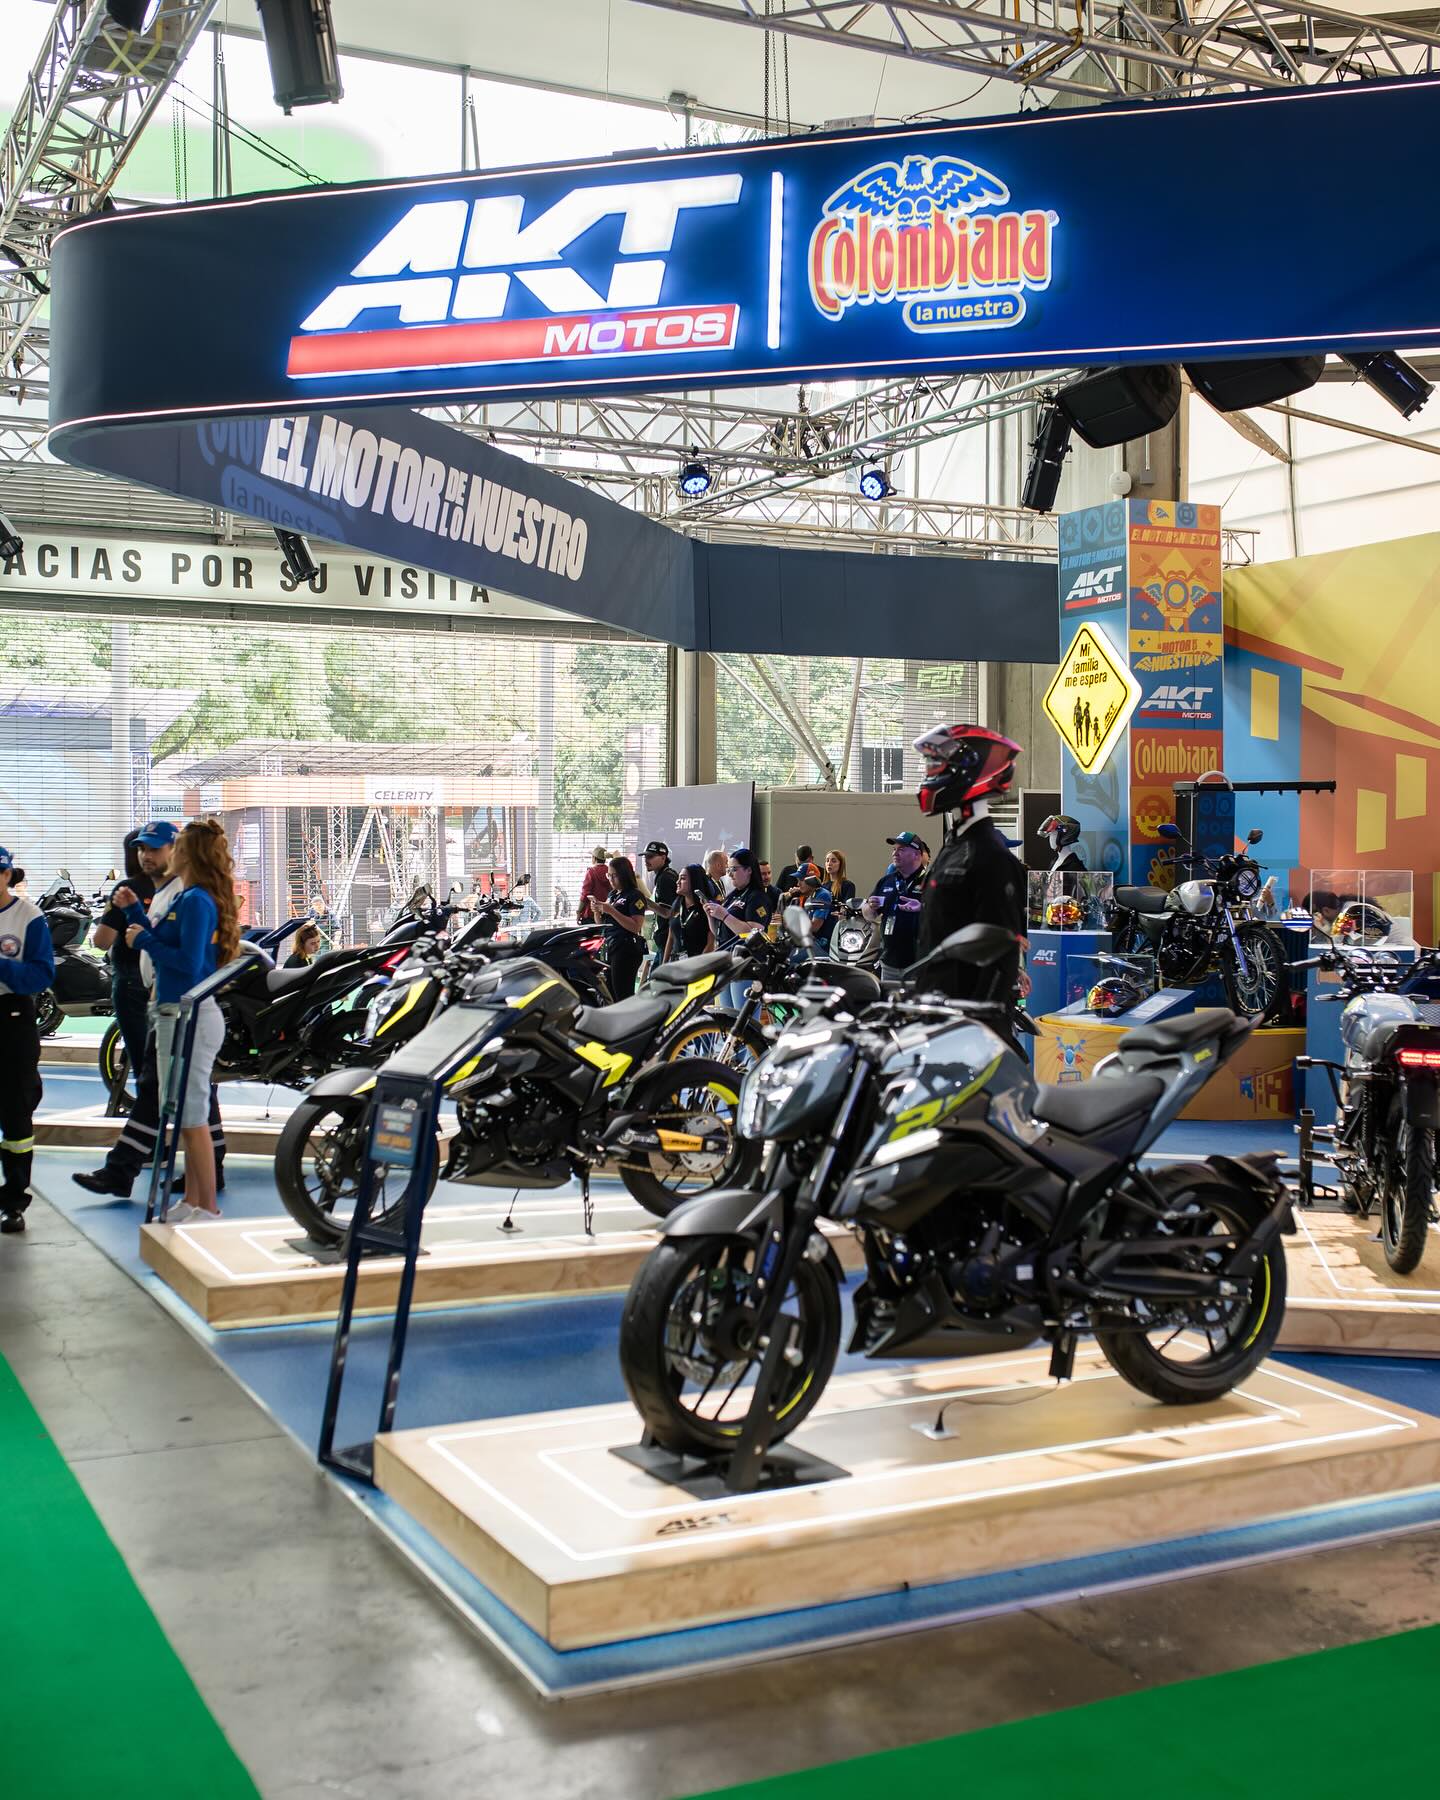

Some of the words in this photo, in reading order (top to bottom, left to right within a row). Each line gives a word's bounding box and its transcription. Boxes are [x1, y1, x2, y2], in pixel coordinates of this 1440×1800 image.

[300, 173, 744, 331] AKT
[811, 209, 1050, 313] Colombiana
[915, 304, 934, 322] la
[936, 299, 1014, 320] nuestra
[543, 312, 727, 354] MOTOS
[260, 415, 310, 488] EL
[310, 415, 446, 533] MOTOR
[445, 466, 469, 502] DE
[438, 497, 464, 541] LO
[462, 474, 588, 581] NUESTRO
[172, 553, 253, 589] POR
[280, 560, 328, 594] SU
[1065, 565, 1122, 601] AKT
[1097, 594, 1122, 604] MOTOS
[1079, 643, 1091, 657] Mi
[1064, 675, 1078, 687] me
[1079, 671, 1107, 688] espera
[1140, 685, 1213, 710] AKT
[1134, 737, 1218, 780] Colombiana
[374, 790, 433, 801] CELERITY
[674, 818, 705, 829] SHAFT
[687, 831, 703, 841] PRO
